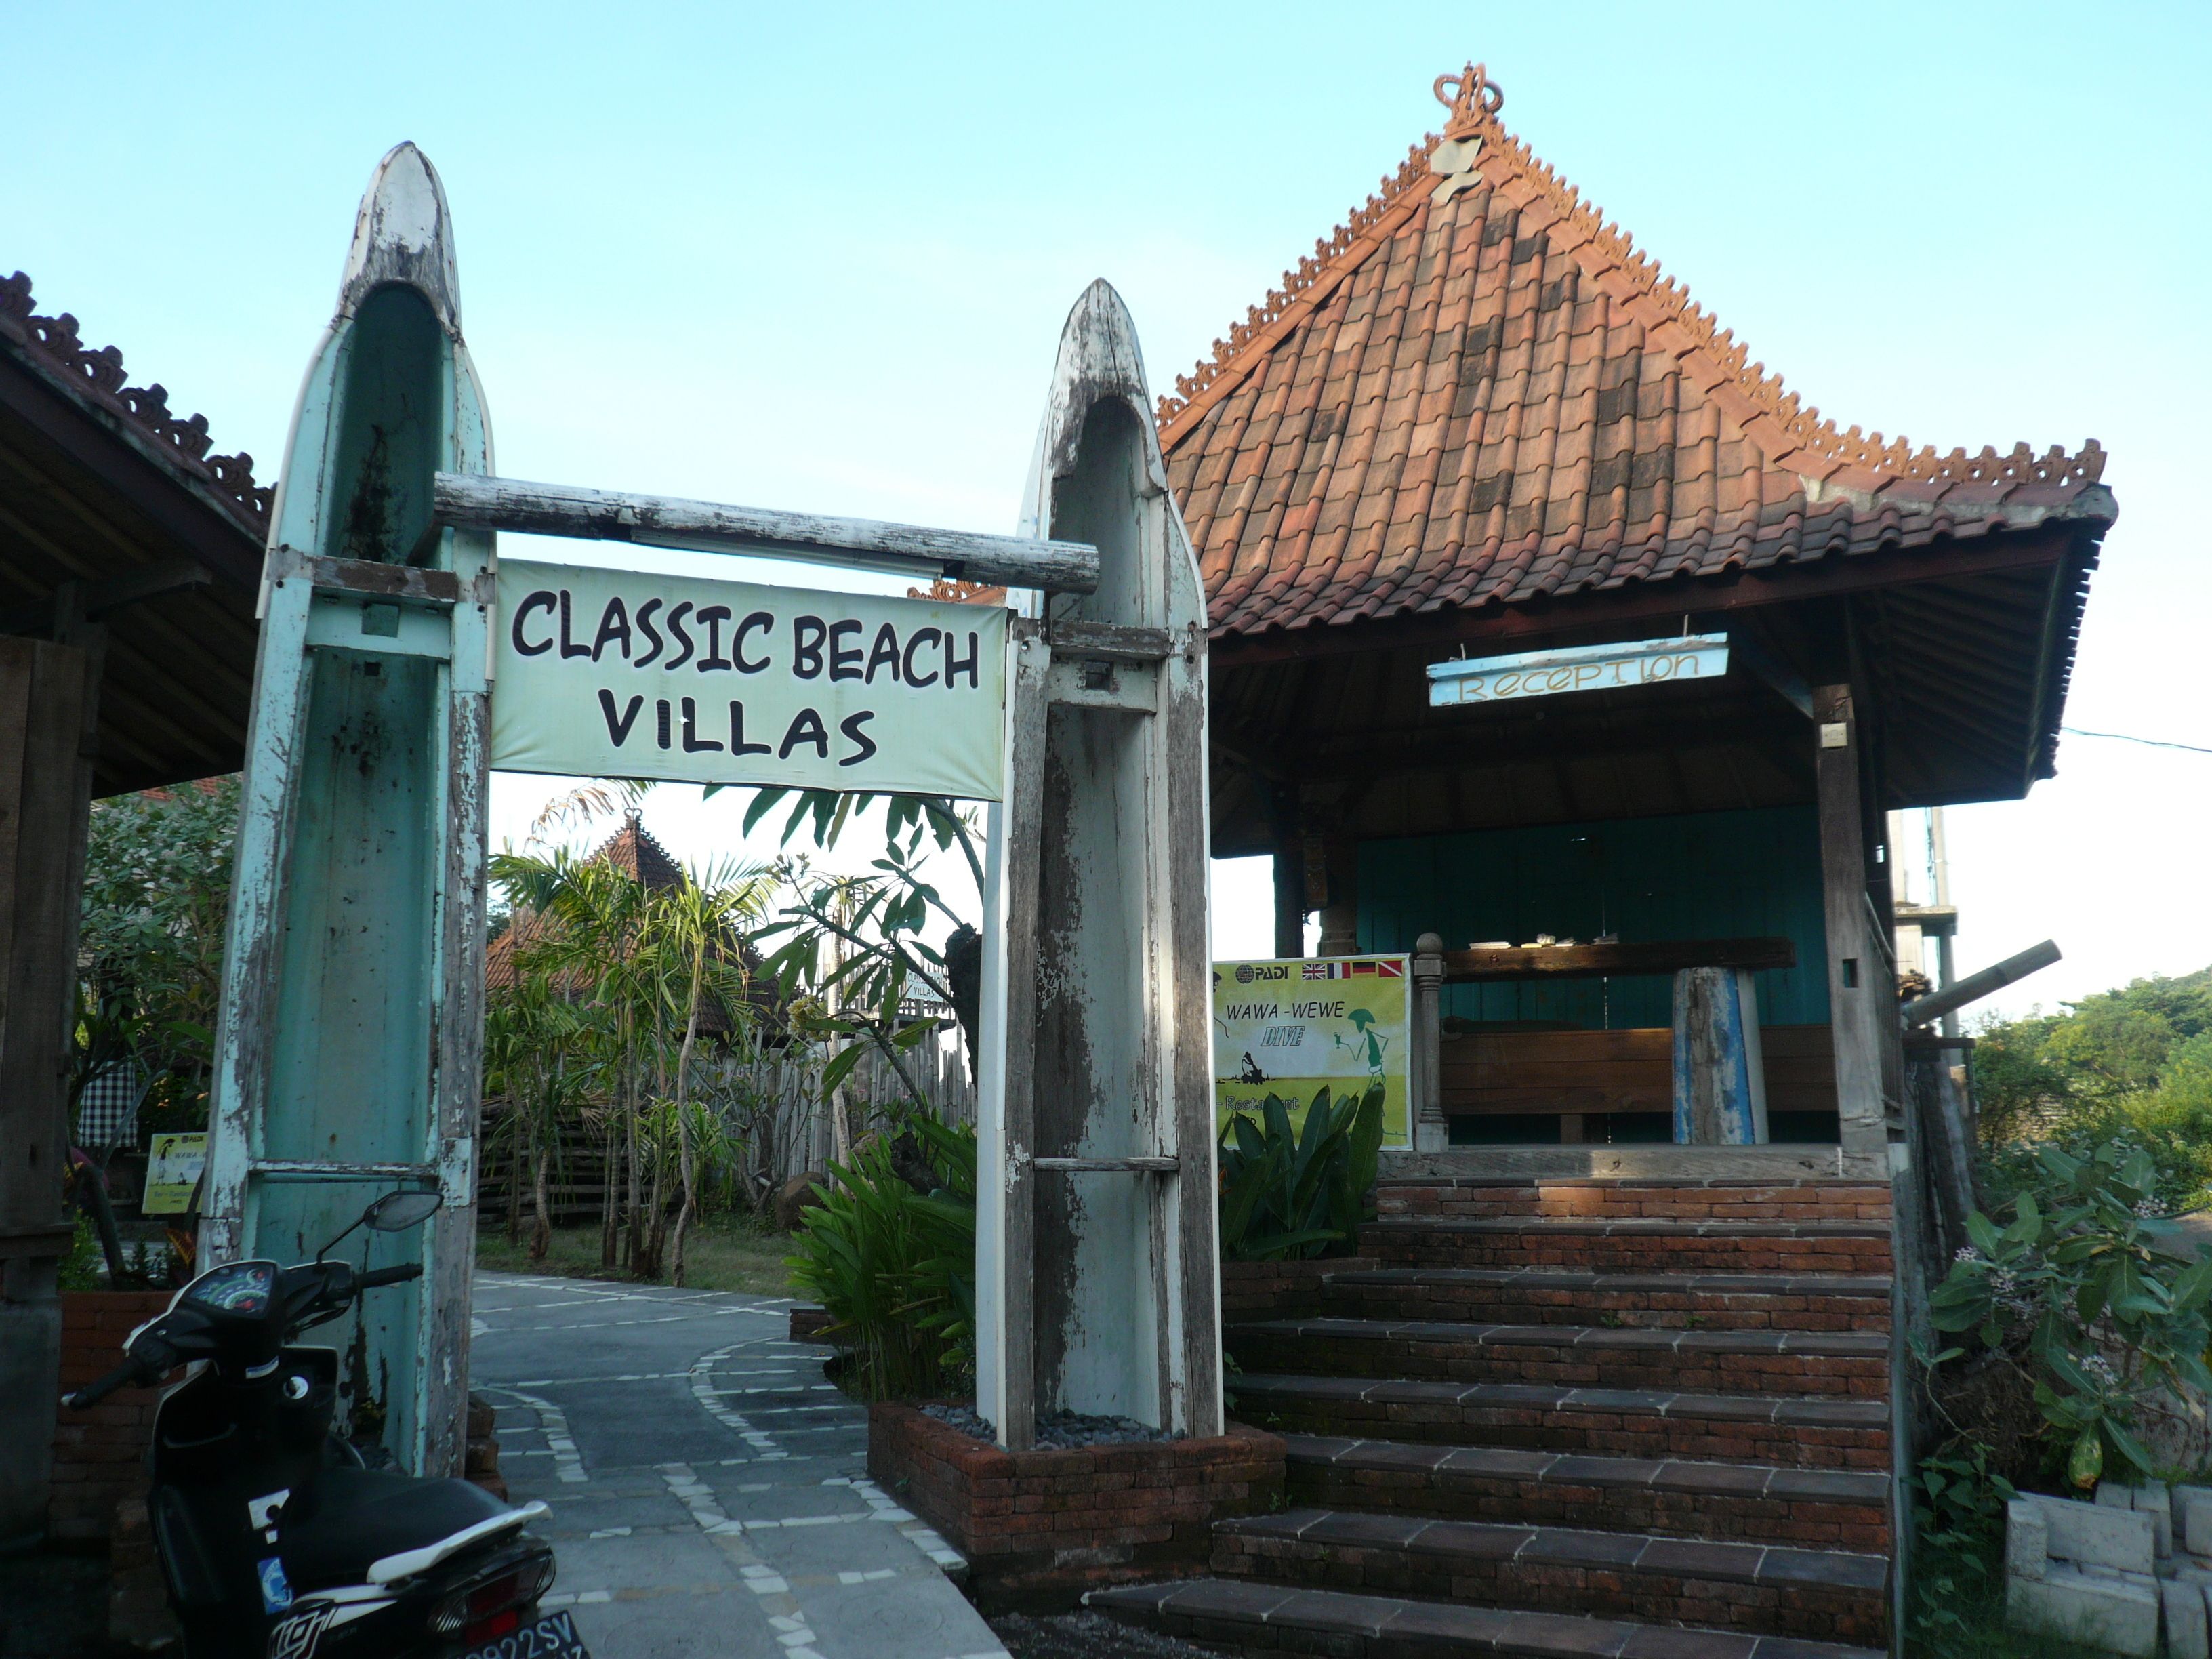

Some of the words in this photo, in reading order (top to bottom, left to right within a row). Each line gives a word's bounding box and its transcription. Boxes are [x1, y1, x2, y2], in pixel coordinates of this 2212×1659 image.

[512, 589, 775, 675] CLASSIC
[792, 615, 979, 690] BEACH
[598, 688, 878, 767] VILLAS
[1256, 966, 1289, 980] PADI
[914, 986, 935, 998] VILLAS
[1227, 1004, 1278, 1020] WAWA
[1260, 1025, 1306, 1047] DIVE
[1225, 1095, 1300, 1111] Restant
